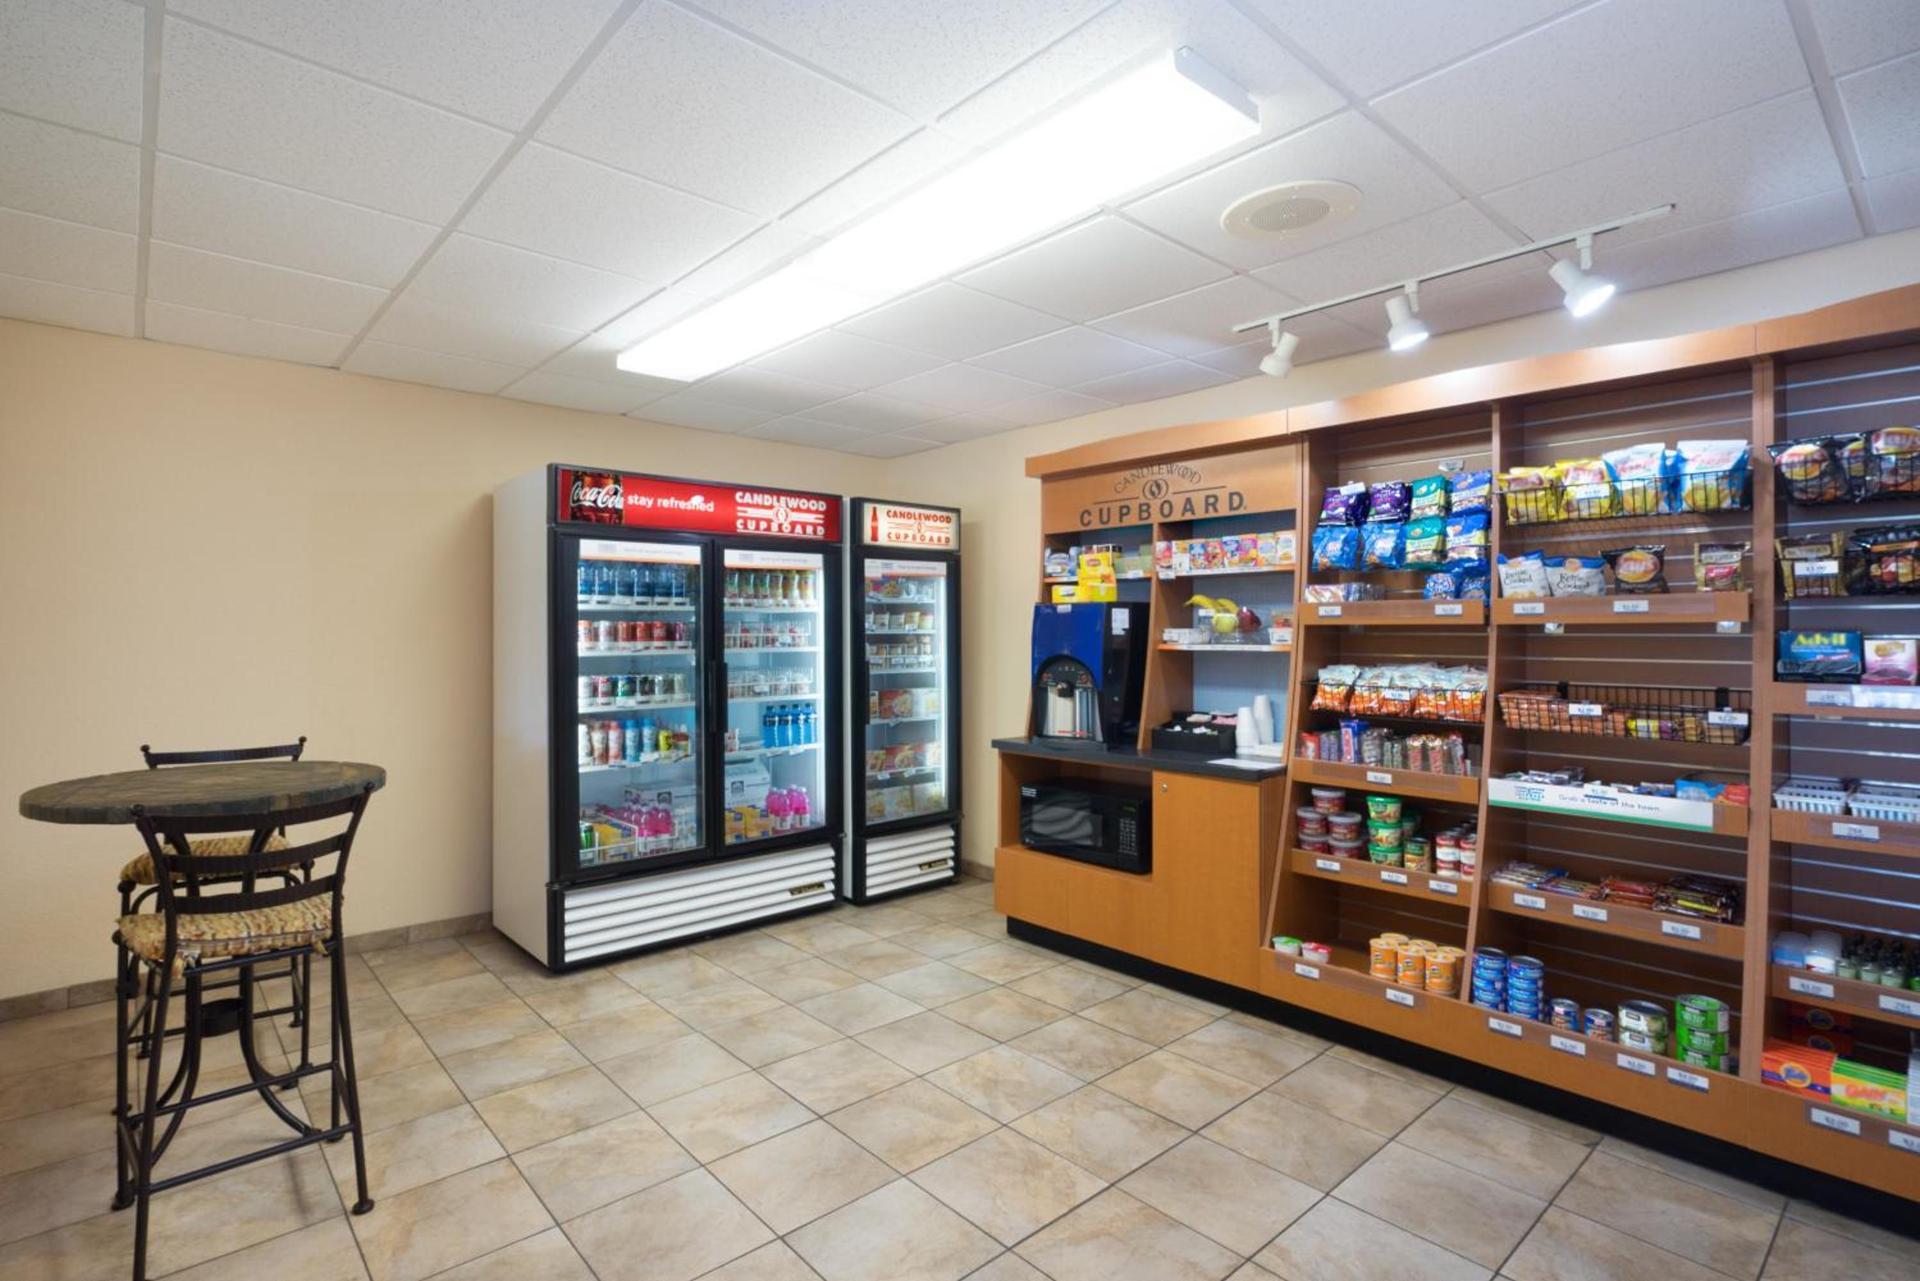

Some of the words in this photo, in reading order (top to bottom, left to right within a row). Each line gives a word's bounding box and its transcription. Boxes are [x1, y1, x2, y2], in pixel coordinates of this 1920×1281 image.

[1114, 463, 1202, 494] CANDLEWOOD
[570, 481, 624, 509] Coca-Cola
[627, 493, 653, 509] stay
[657, 496, 715, 513] refreshed
[735, 491, 827, 512] CANDLEWOOD
[886, 510, 952, 524] CANDLEWOOD
[1079, 491, 1245, 527] CUPBOARD
[736, 518, 826, 536] CUPBOARD
[887, 531, 951, 544] CUPBOARD
[1795, 632, 1847, 646] Advil
